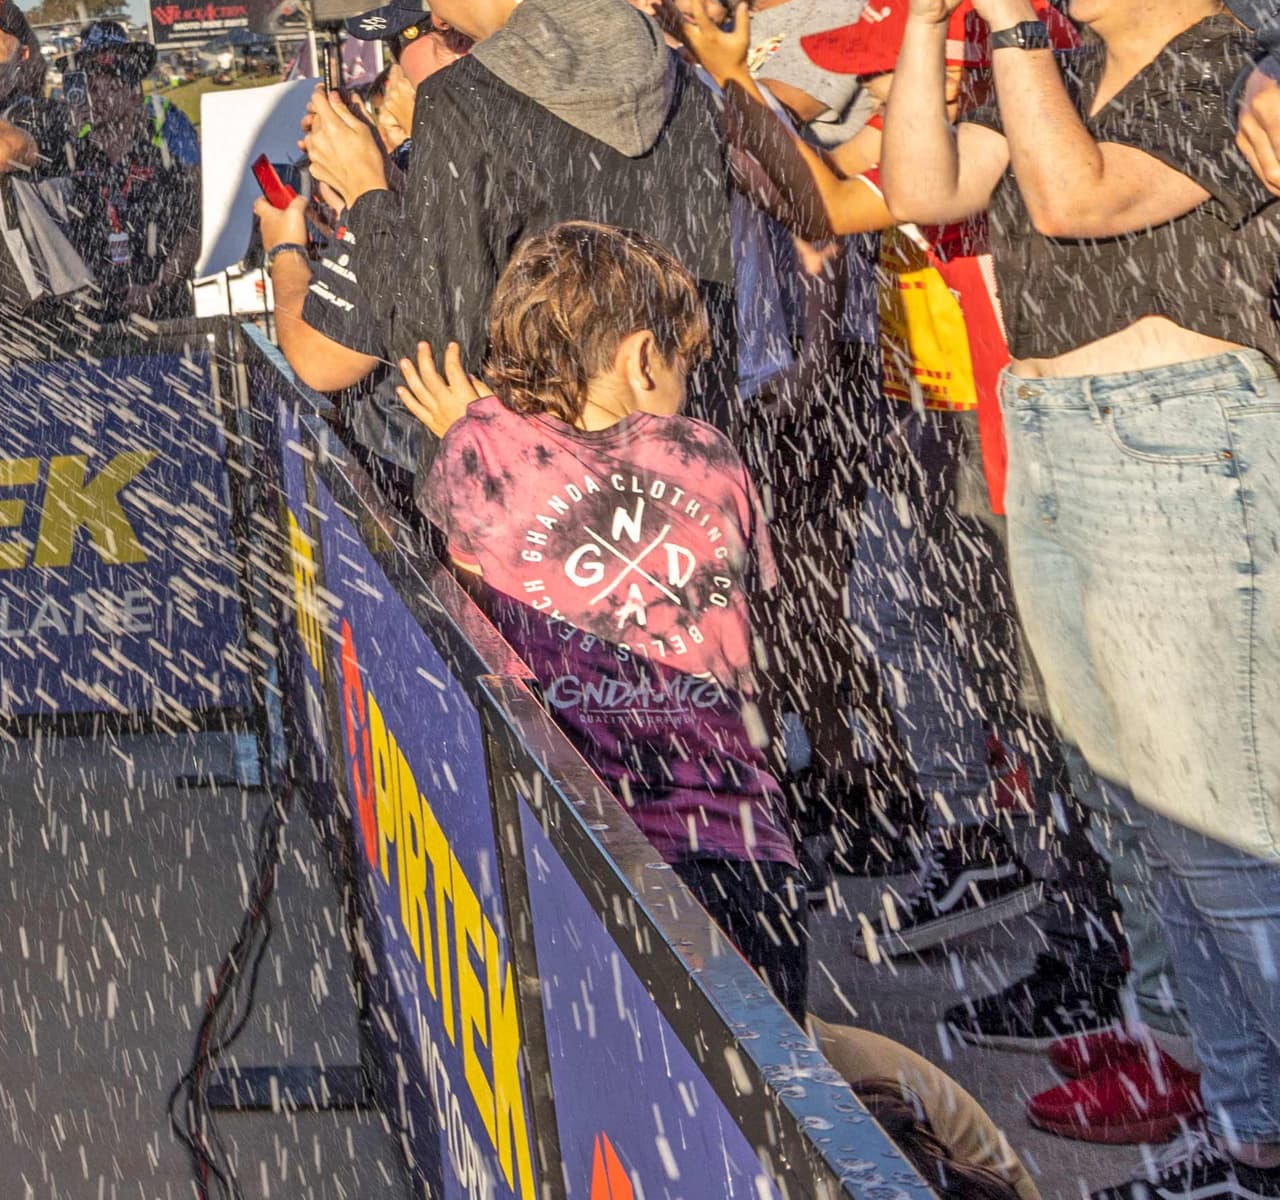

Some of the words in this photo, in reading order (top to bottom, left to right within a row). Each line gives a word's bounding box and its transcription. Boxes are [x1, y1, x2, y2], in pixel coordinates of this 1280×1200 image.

[522, 474, 600, 562] GHANDA
[611, 473, 728, 560] CLOTHING
[0, 589, 154, 639] LANE
[367, 689, 536, 1200] PIRTEK
